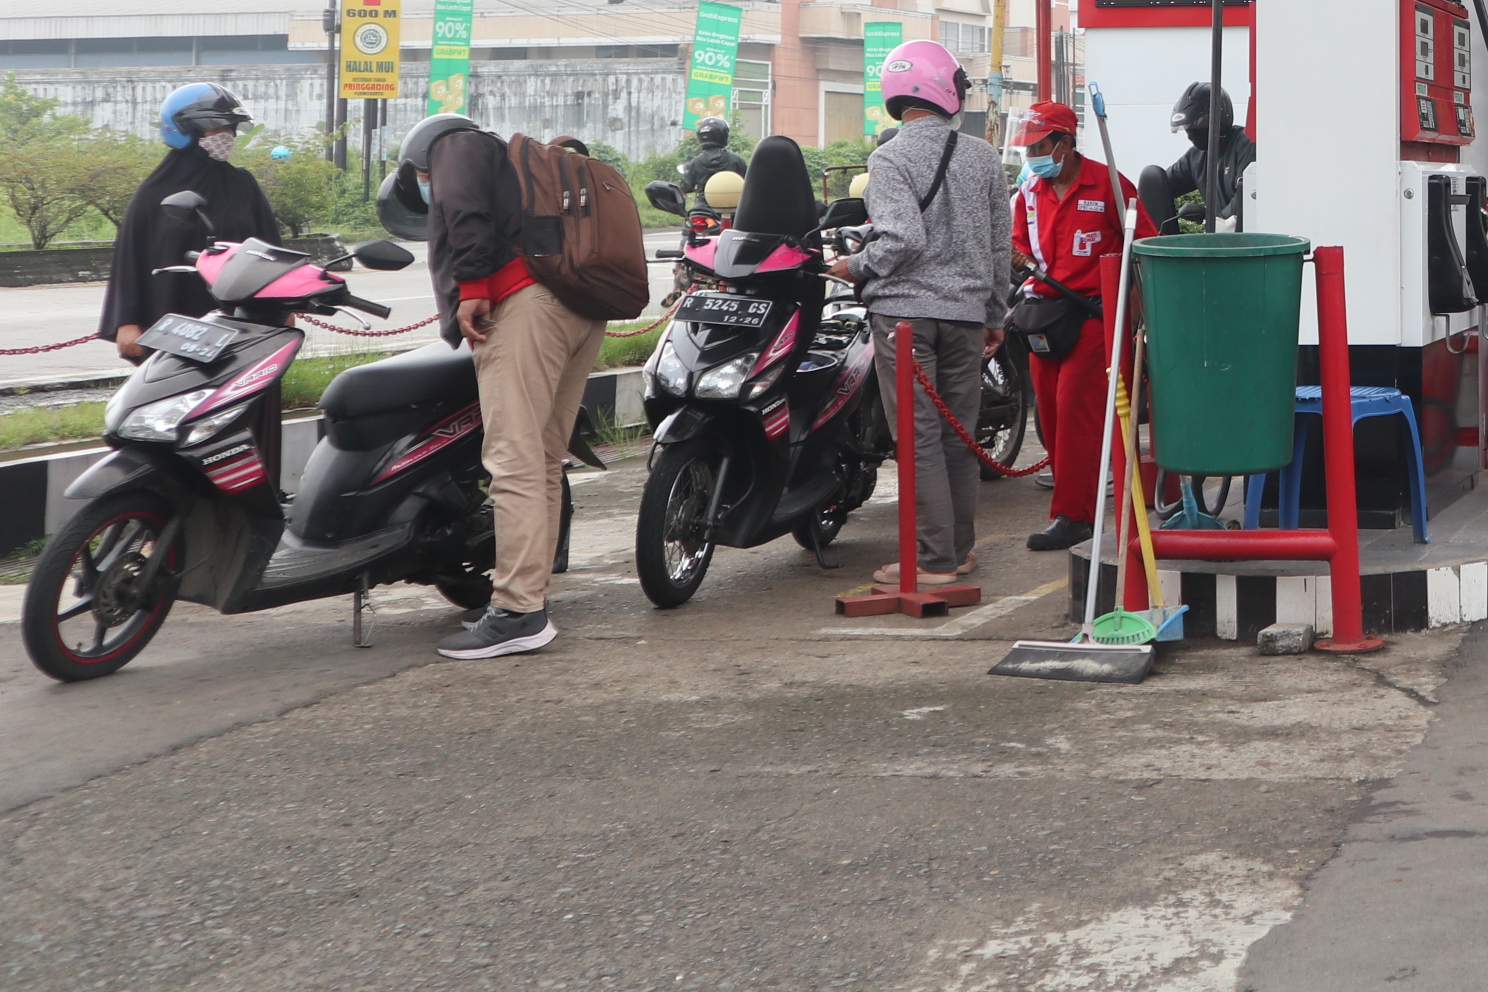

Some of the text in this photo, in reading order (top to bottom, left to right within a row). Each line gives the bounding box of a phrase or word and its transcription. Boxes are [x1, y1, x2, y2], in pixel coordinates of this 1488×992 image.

[346, 9, 397, 19] 600 M
[699, 11, 738, 23] GrabExpress
[345, 61, 394, 73] HALAL MUI
[693, 71, 730, 83] GRABPWT
[343, 83, 395, 92] PRINGGADING
[683, 297, 692, 309] R
[703, 299, 738, 312] 5245
[156, 318, 224, 348] R 4082 L
[233, 363, 279, 388] VARIO
[762, 398, 786, 416] HONDA
[202, 443, 252, 466] HONDA
